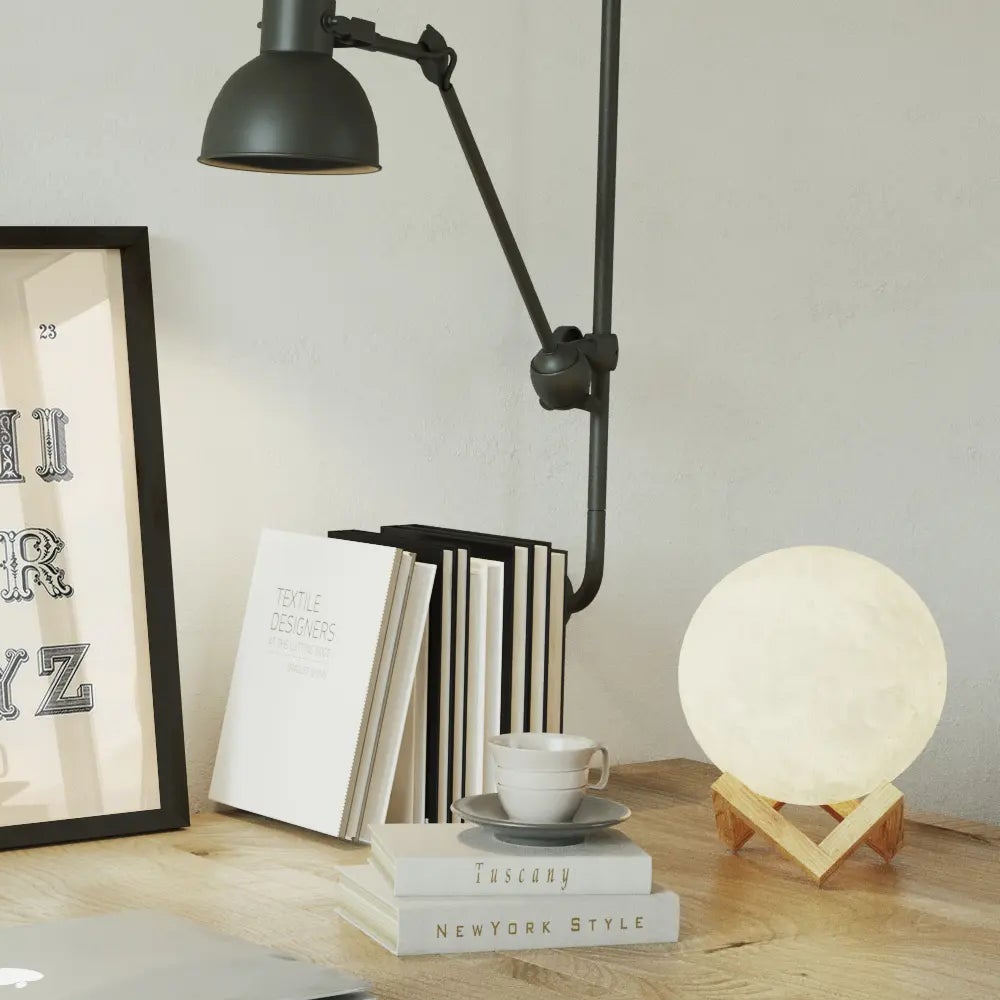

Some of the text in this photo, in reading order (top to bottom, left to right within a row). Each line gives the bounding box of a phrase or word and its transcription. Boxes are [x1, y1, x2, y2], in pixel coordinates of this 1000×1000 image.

[39, 323, 57, 339] 23
[276, 587, 322, 613] TEXTILE
[269, 611, 336, 642] DESIGNERS
[475, 862, 570, 891] Tuscany
